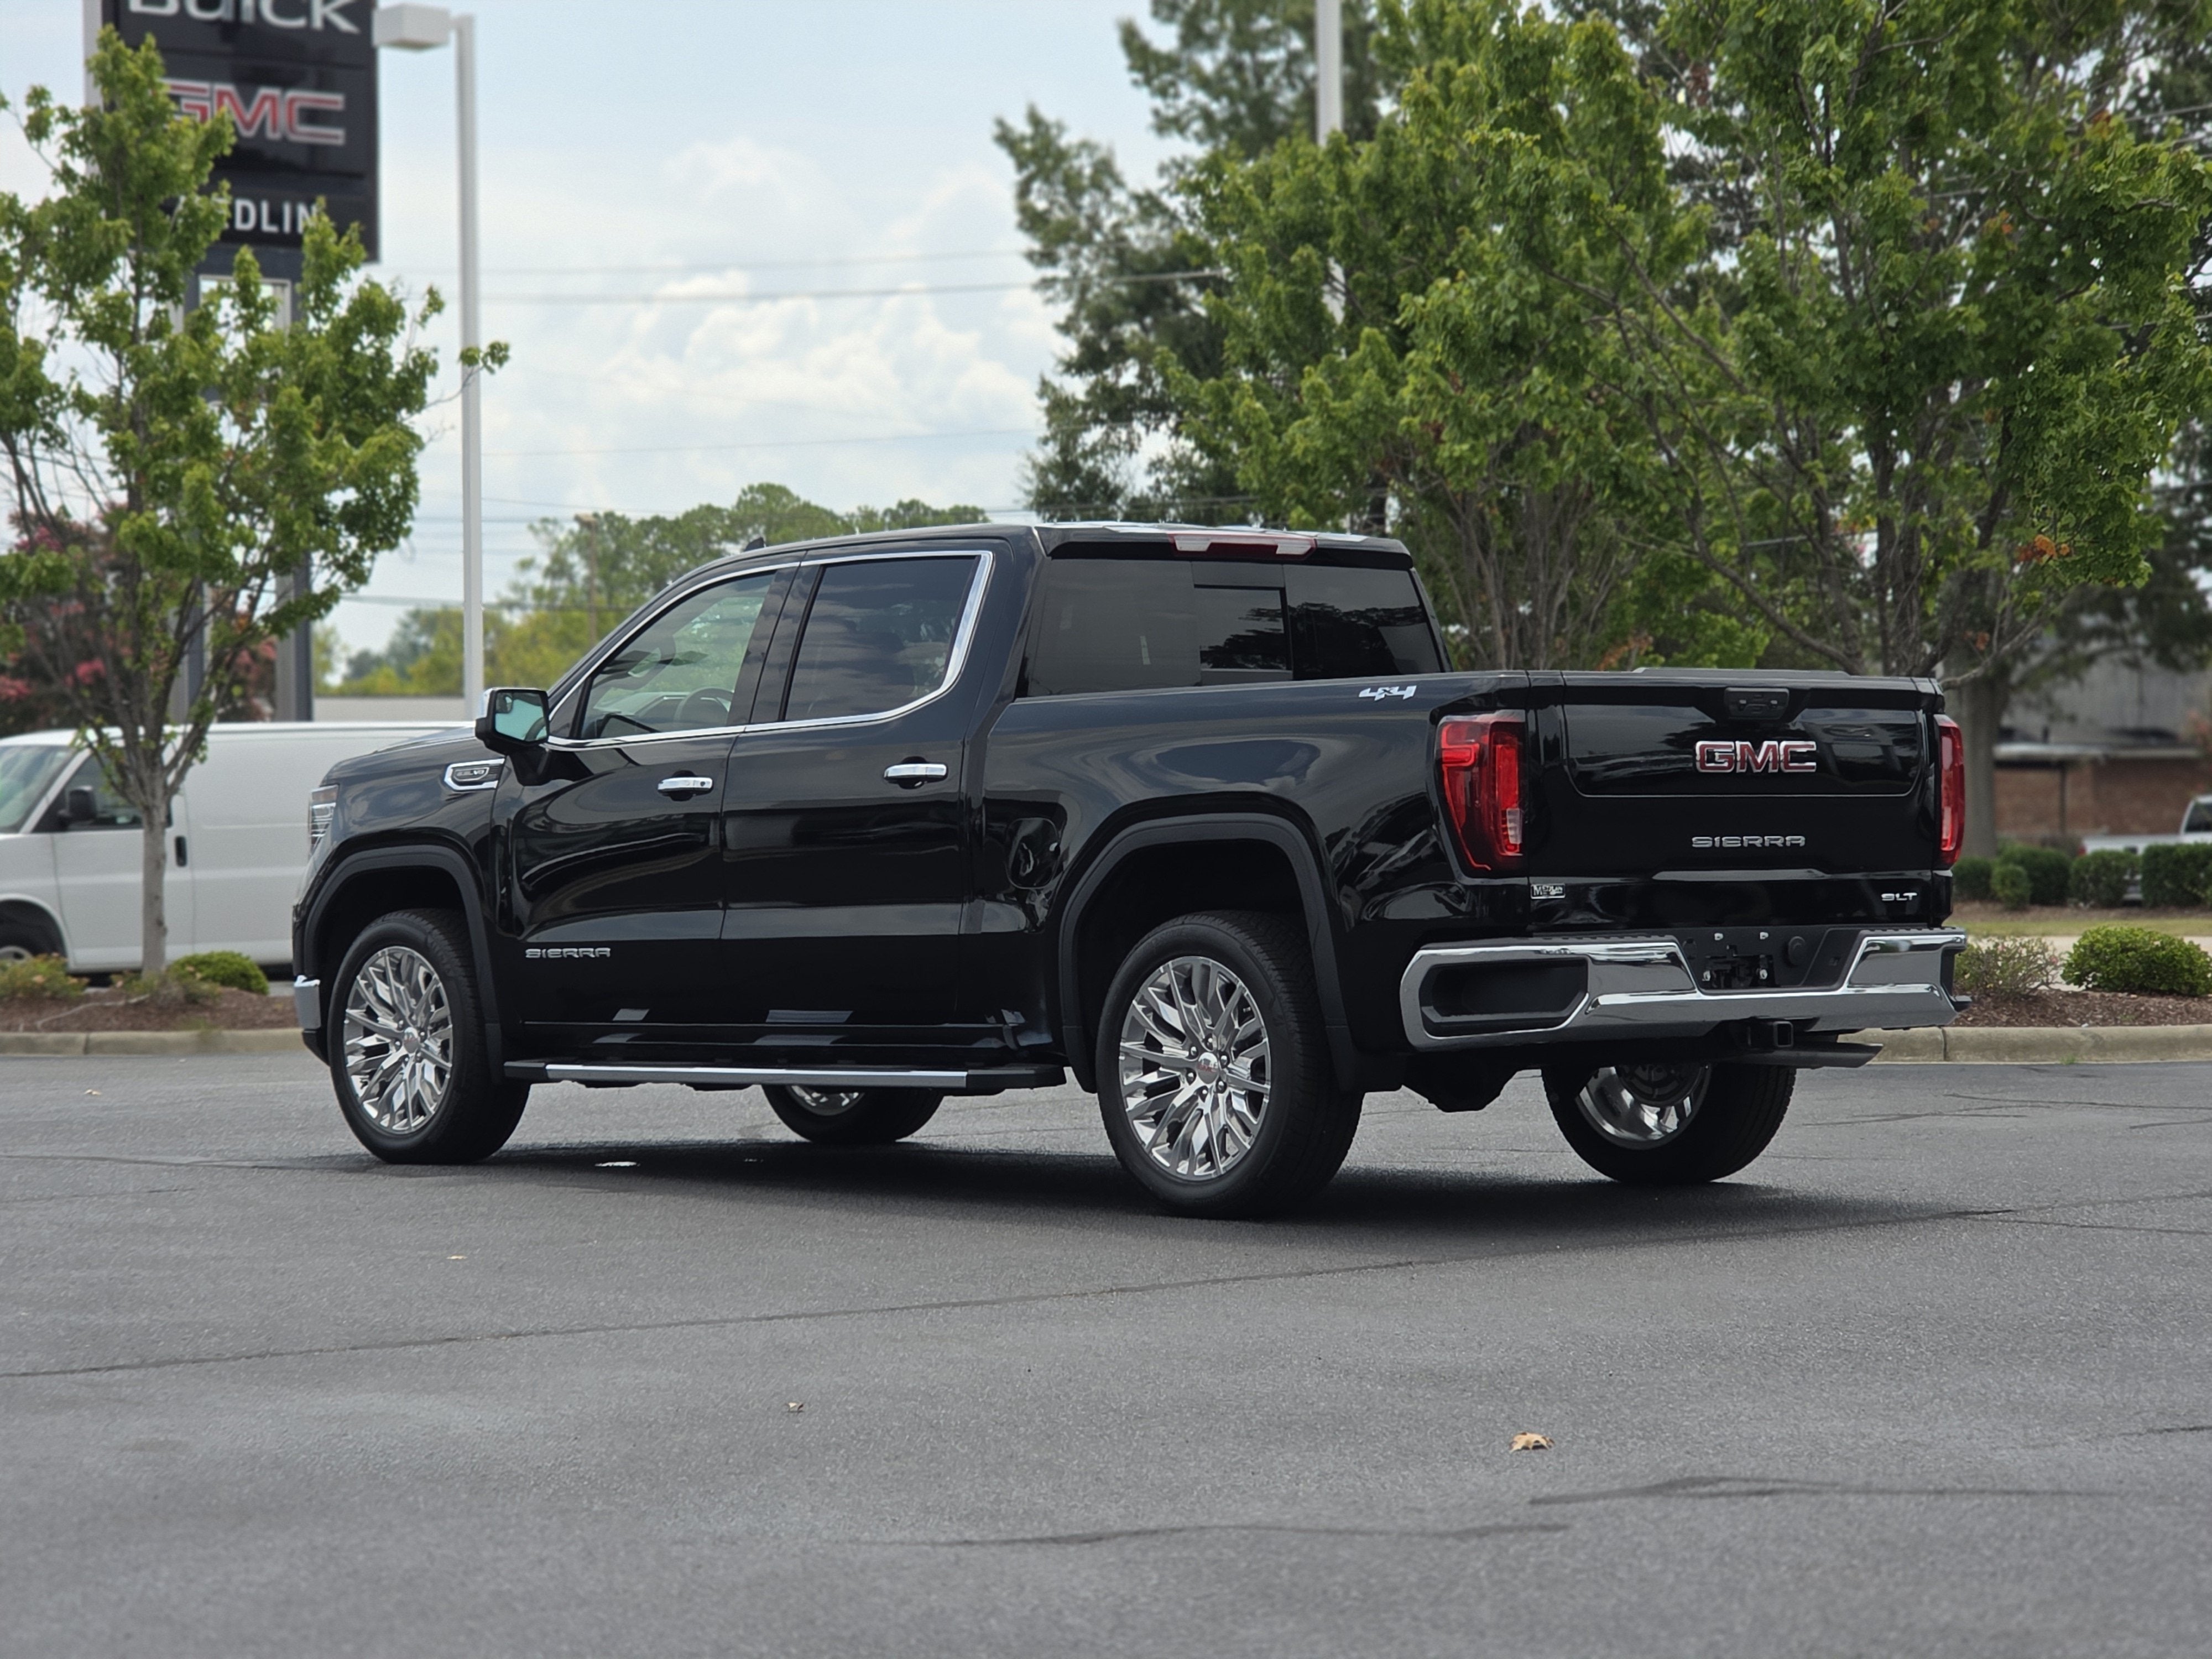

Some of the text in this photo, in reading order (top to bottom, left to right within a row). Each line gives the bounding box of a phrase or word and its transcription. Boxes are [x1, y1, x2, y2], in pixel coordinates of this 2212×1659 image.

[1695, 740, 1817, 773] GMC
[1692, 836, 1806, 848] SIERRA
[1881, 892, 1918, 901] SLT
[525, 947, 611, 959] SIERRA
